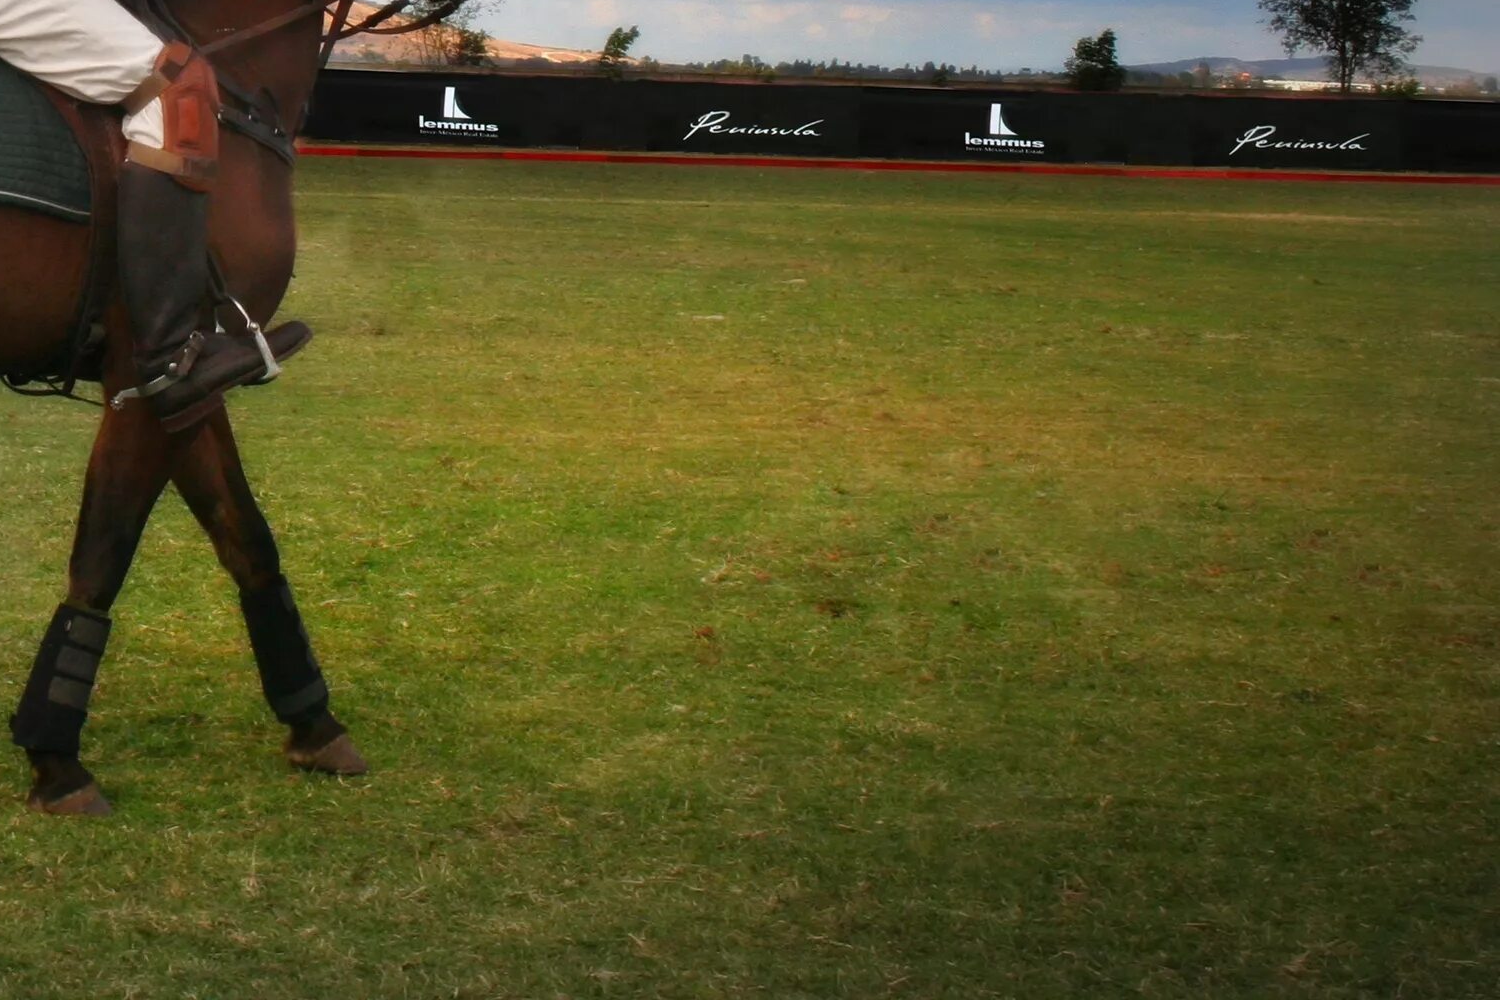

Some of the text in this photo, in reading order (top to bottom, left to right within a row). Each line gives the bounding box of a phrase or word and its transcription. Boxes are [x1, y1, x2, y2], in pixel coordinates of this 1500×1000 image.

[418, 115, 499, 132] lemmus
[683, 110, 824, 140] Peninsula
[964, 132, 1045, 148] lemmus
[1228, 125, 1371, 156] Peninsula
